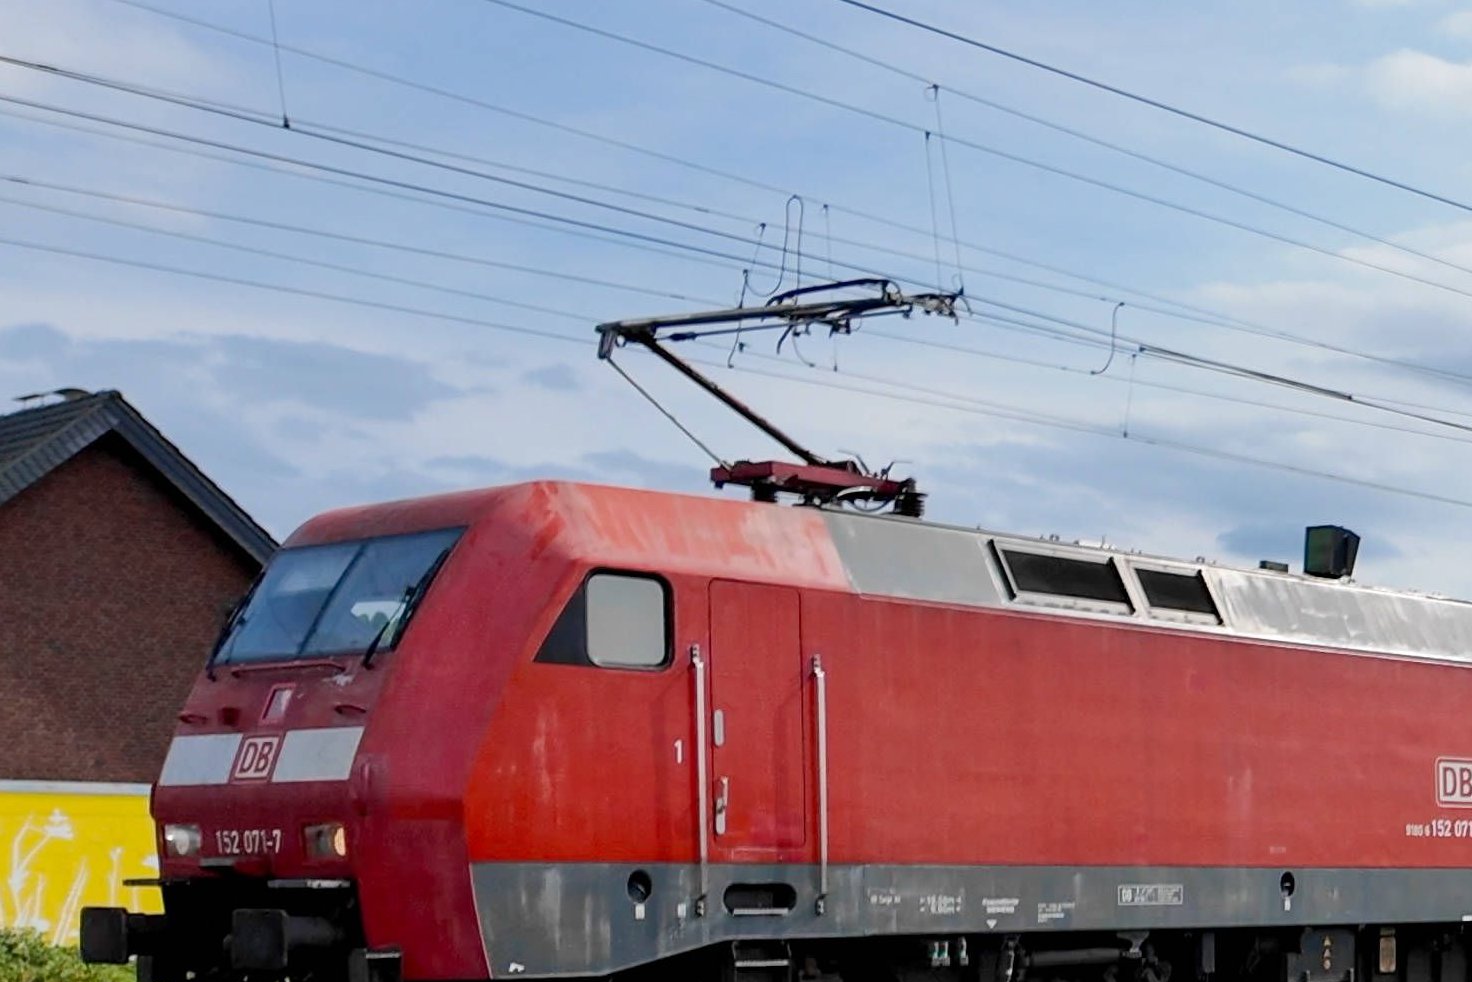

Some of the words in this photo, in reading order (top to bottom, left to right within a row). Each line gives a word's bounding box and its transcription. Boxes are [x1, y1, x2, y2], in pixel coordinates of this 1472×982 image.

[239, 741, 274, 774] DB
[674, 739, 683, 764] 1
[215, 829, 241, 854] 152
[243, 828, 282, 854] 071-7
[1431, 819, 1452, 838] 152
